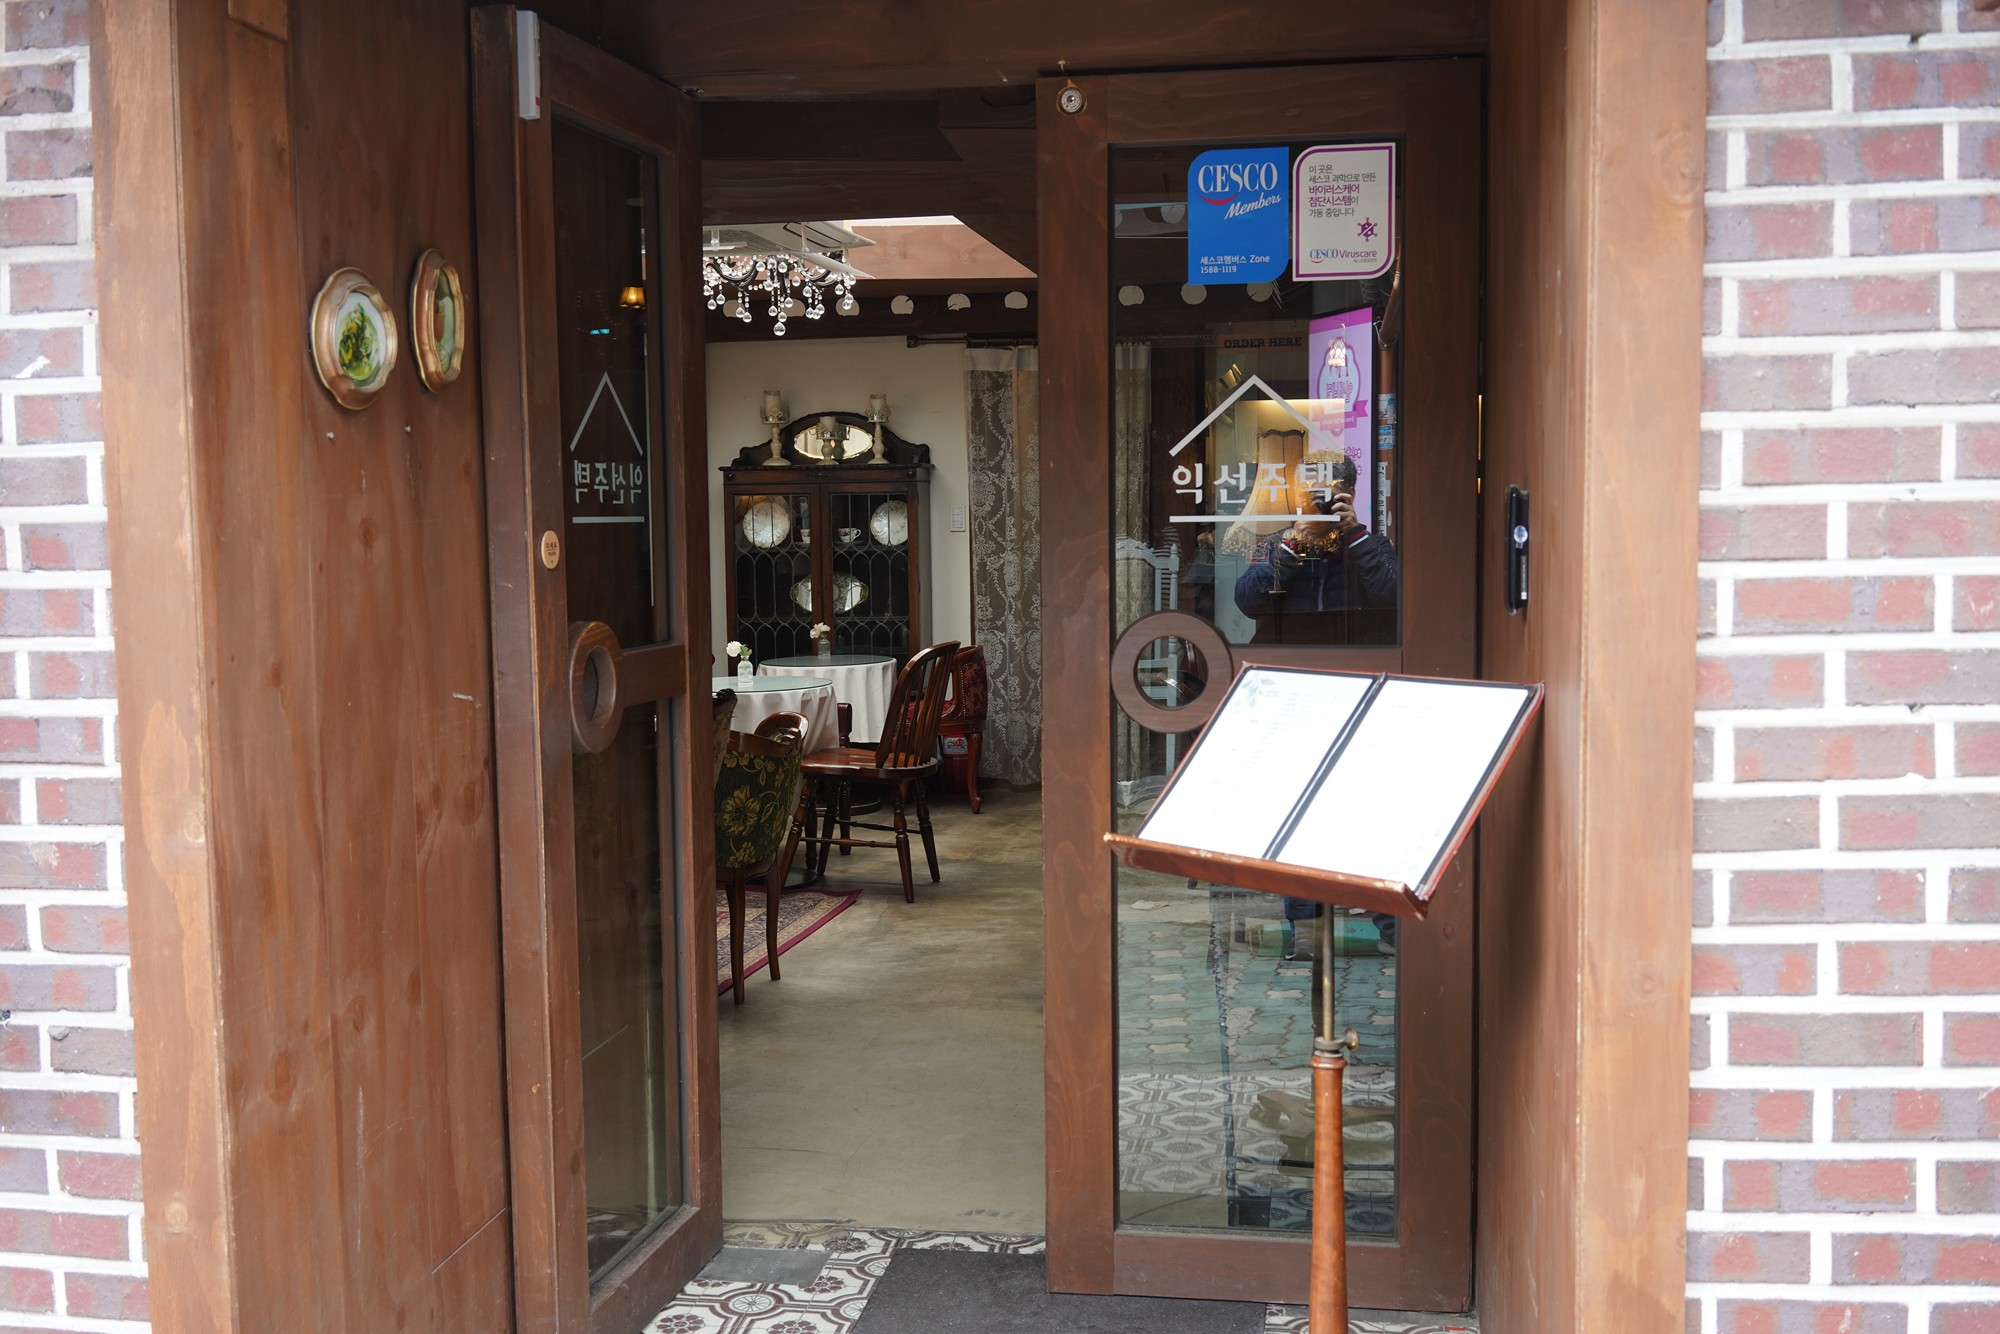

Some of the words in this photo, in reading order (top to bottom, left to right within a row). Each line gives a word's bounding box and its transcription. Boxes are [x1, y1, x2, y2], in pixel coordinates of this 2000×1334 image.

[1309, 165, 1316, 174] 이
[1318, 164, 1333, 174] 곳은
[1198, 162, 1278, 193] CESCO
[1309, 174, 1330, 183] 세스코
[1332, 173, 1361, 183] 과학으로
[1361, 172, 1377, 182] 만든
[1309, 183, 1360, 195] 바이러스케어
[1224, 192, 1281, 220] Members
[1309, 195, 1359, 207] 첨단시스템이
[1309, 208, 1323, 218] 가동
[1325, 207, 1355, 218] 중입니다
[1200, 255, 1247, 265] 세스코멤버스
[1249, 254, 1270, 263] Zone
[1309, 248, 1339, 260] CESCO
[1340, 250, 1377, 258] Viruscare
[1200, 265, 1237, 274] 1588-1119
[1224, 338, 1265, 348] ORDER
[1269, 336, 1302, 347] HERE
[1172, 462, 1333, 505] 익선주택
